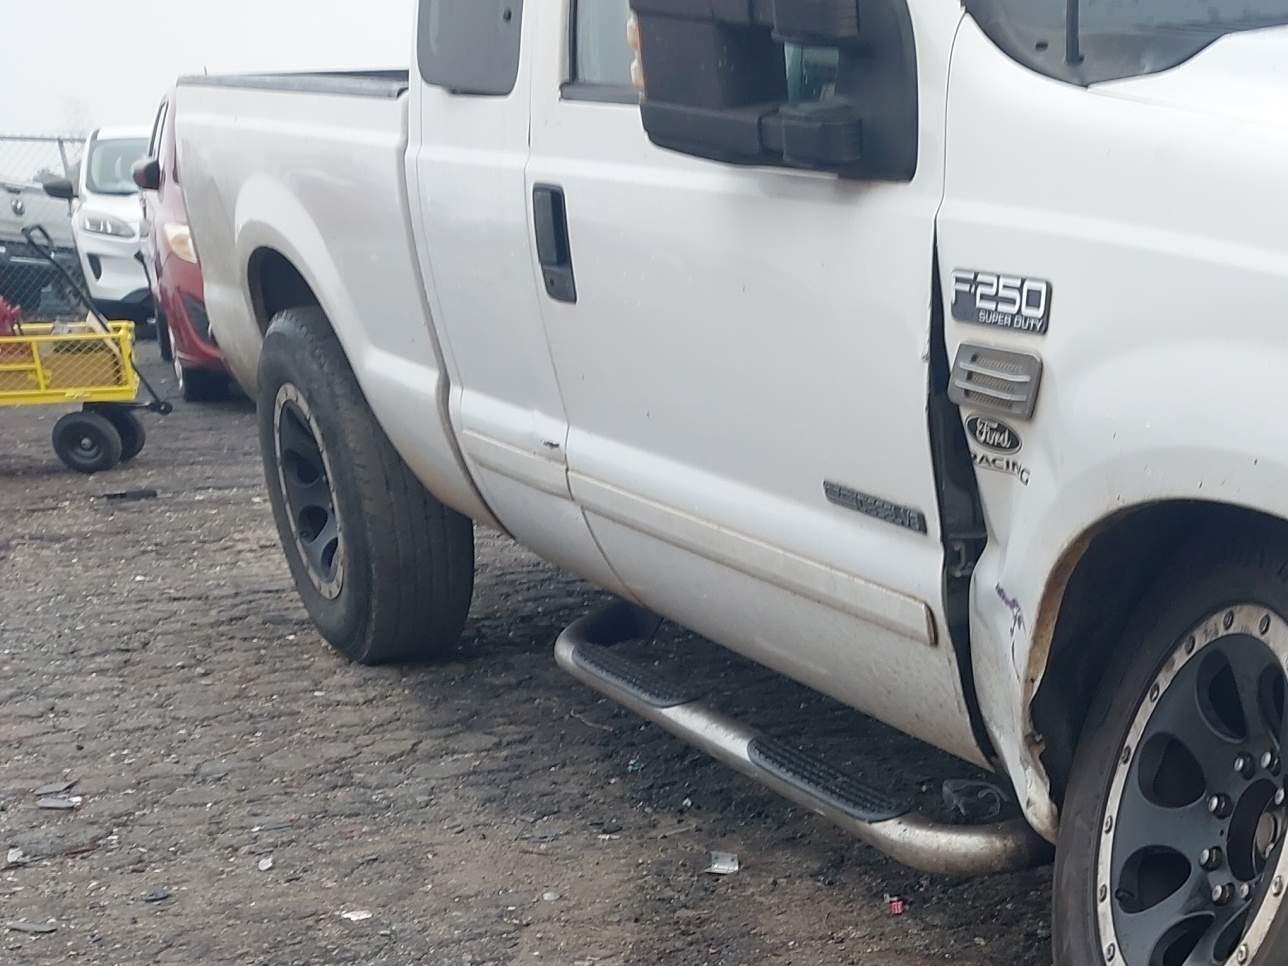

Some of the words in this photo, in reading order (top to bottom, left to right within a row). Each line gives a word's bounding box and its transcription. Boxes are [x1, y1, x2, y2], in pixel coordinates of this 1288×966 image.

[979, 309, 1011, 328] SUPER
[1013, 314, 1042, 332] DUTY
[975, 418, 1012, 449] Ford
